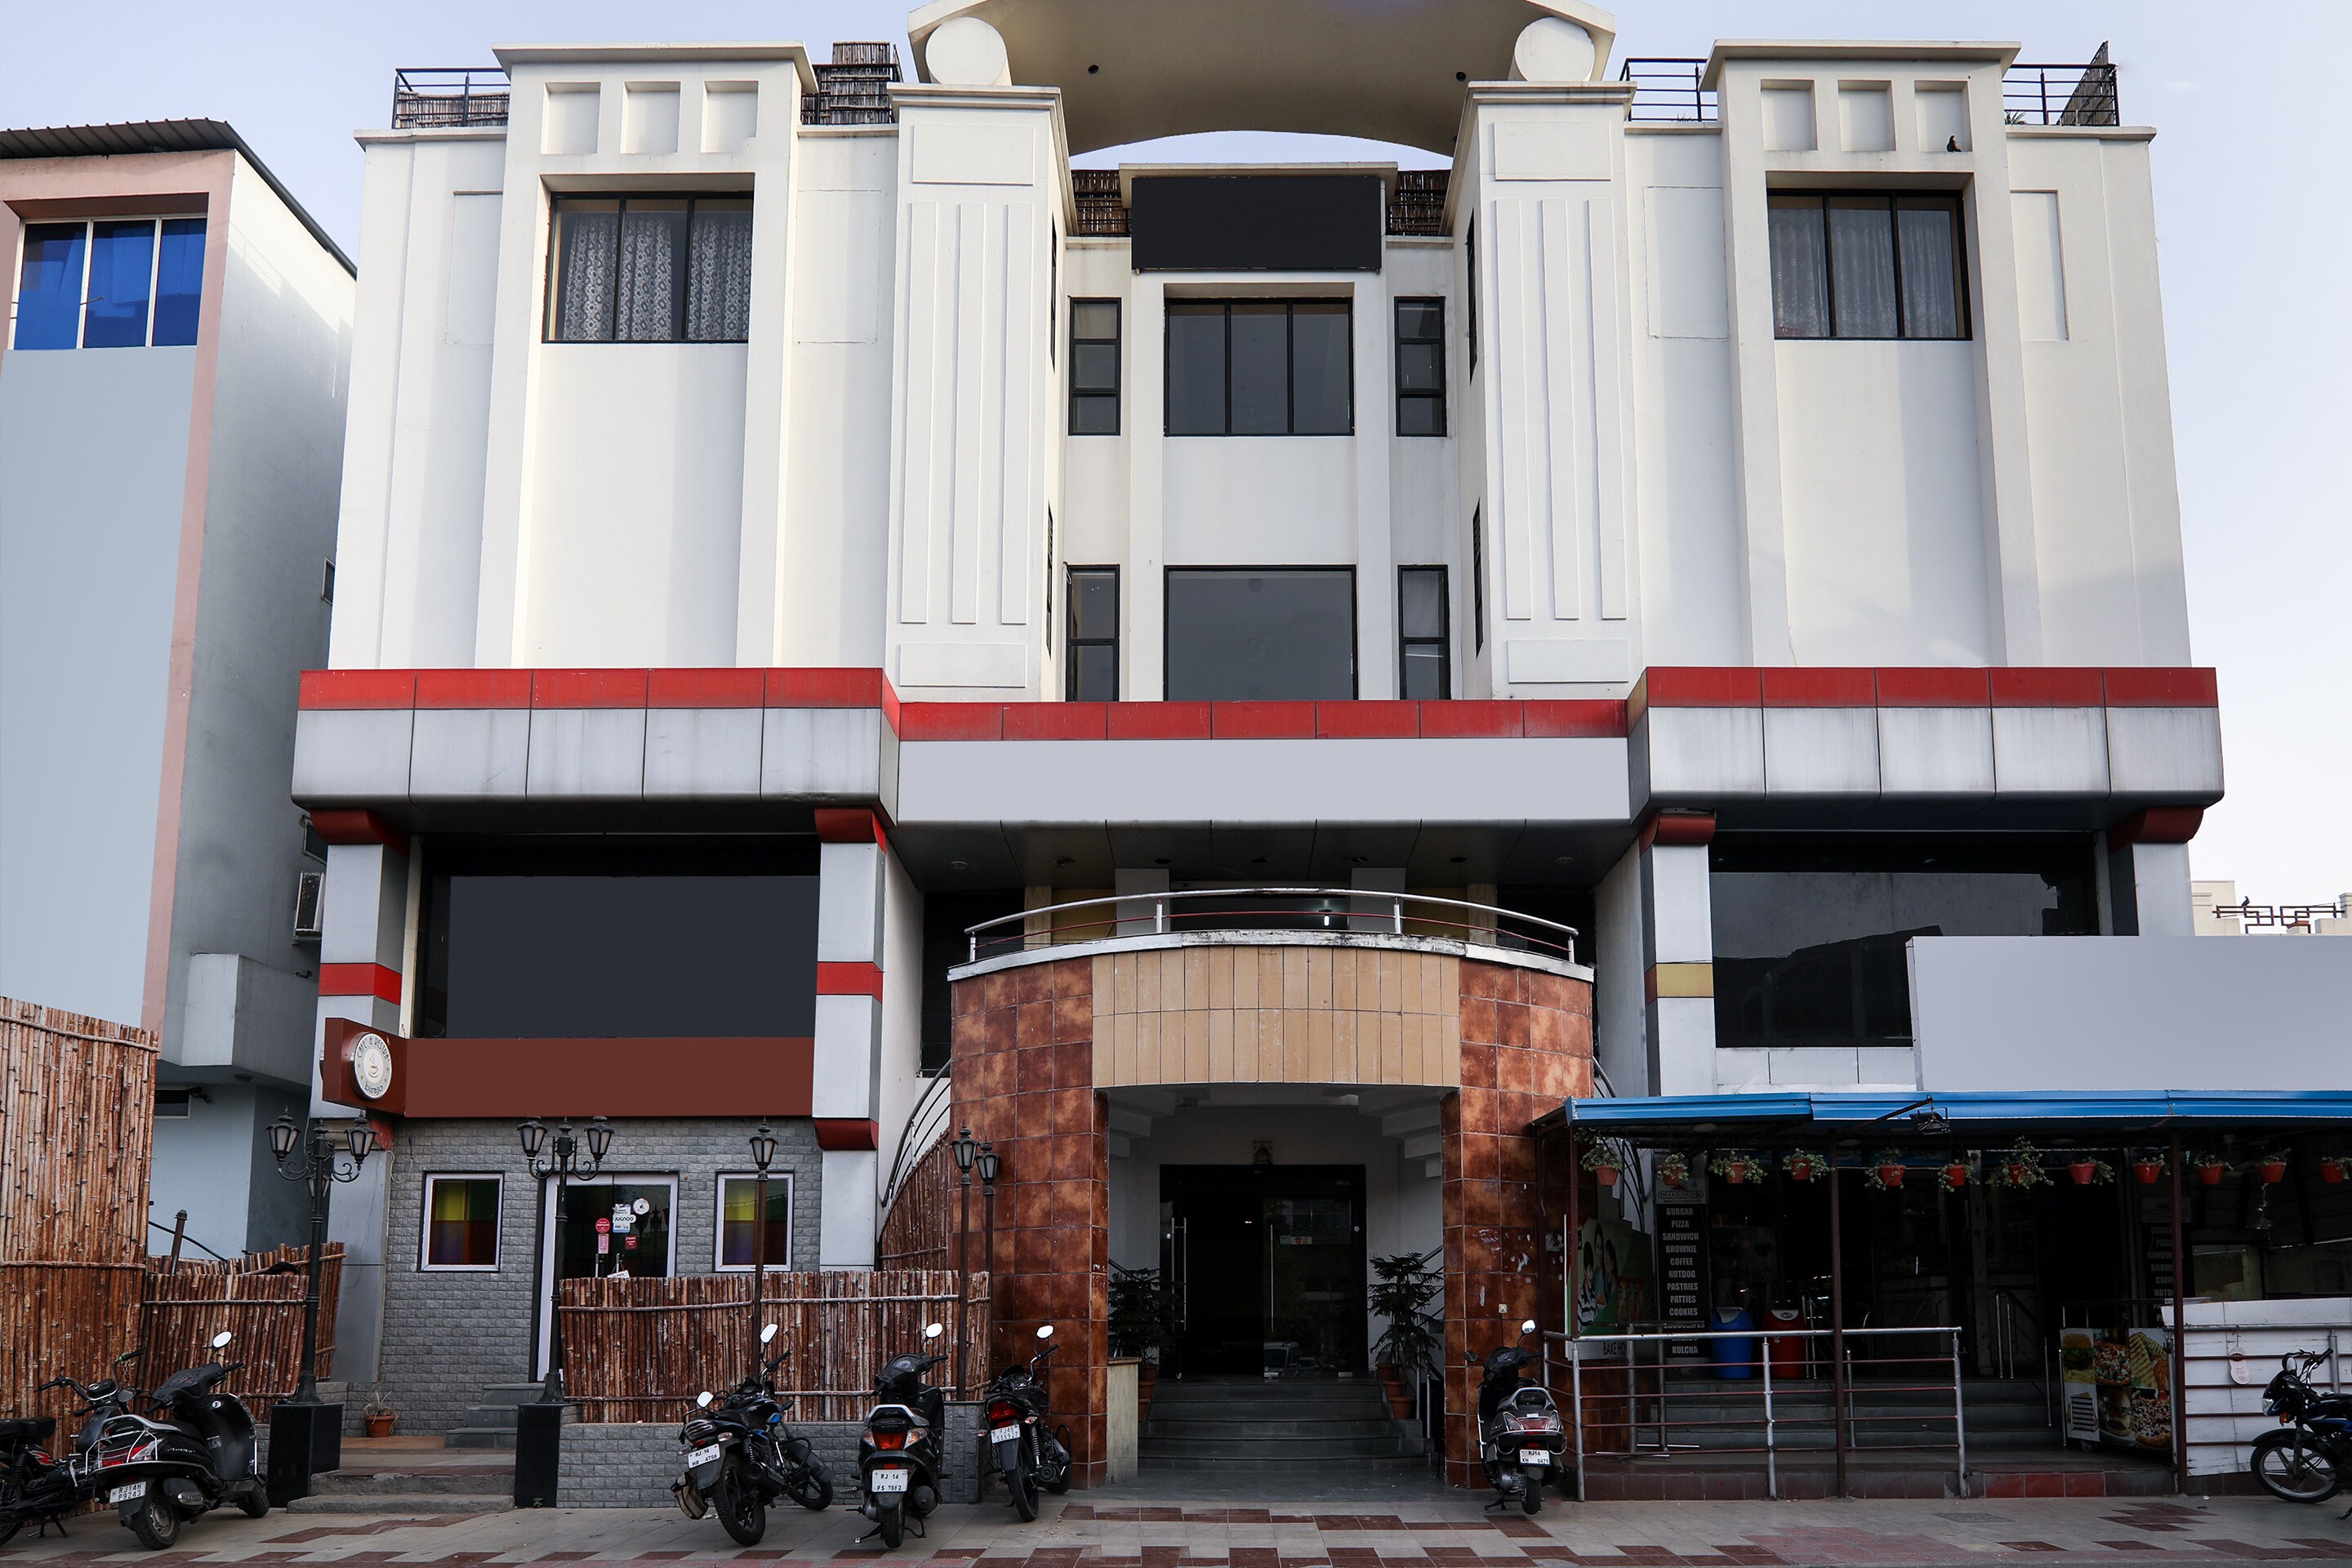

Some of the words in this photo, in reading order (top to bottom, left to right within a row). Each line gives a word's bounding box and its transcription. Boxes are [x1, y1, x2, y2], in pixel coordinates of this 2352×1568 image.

[1666, 1207, 1694, 1216] BURGAR
[1671, 1220, 1690, 1228] PIZZA
[1662, 1232, 1699, 1241] SANDWICH
[1665, 1245, 1697, 1254] BROWNIE
[1670, 1258, 1694, 1266] COFFEE
[1668, 1270, 1696, 1278] HOTDOG
[1667, 1282, 1699, 1291] PASTRIES
[1670, 1295, 1696, 1303] PATTIES
[1669, 1307, 1698, 1316] COOKIES
[1603, 1342, 1617, 1356] BAKE
[1672, 1345, 1699, 1354] KULCHA
[118, 1483, 142, 1494] RJ14H
[118, 1490, 141, 1500] P9243
